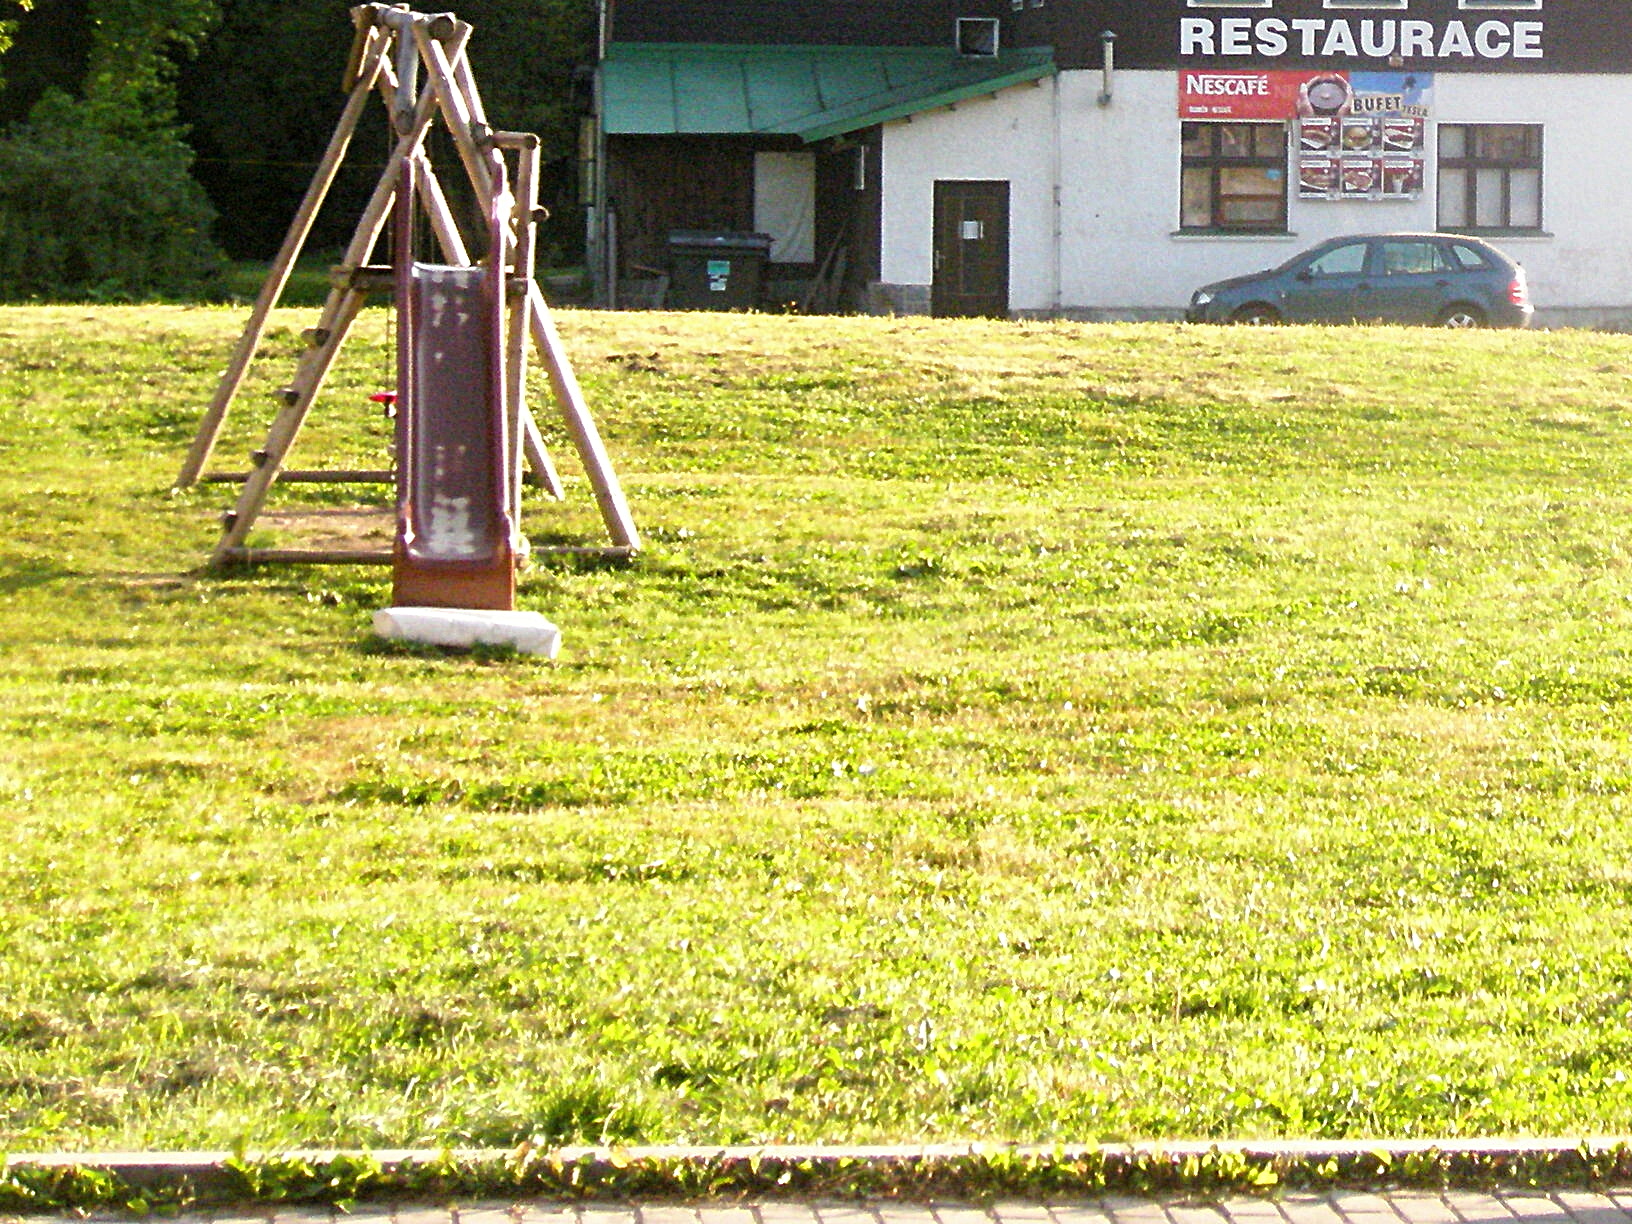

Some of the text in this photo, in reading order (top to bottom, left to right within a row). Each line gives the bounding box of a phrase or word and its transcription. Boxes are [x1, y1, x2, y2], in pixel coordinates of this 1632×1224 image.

[1180, 17, 1544, 59] RESTAURACE
[1186, 73, 1270, 95] NESCAFÉ
[1353, 96, 1401, 112] BUFET
